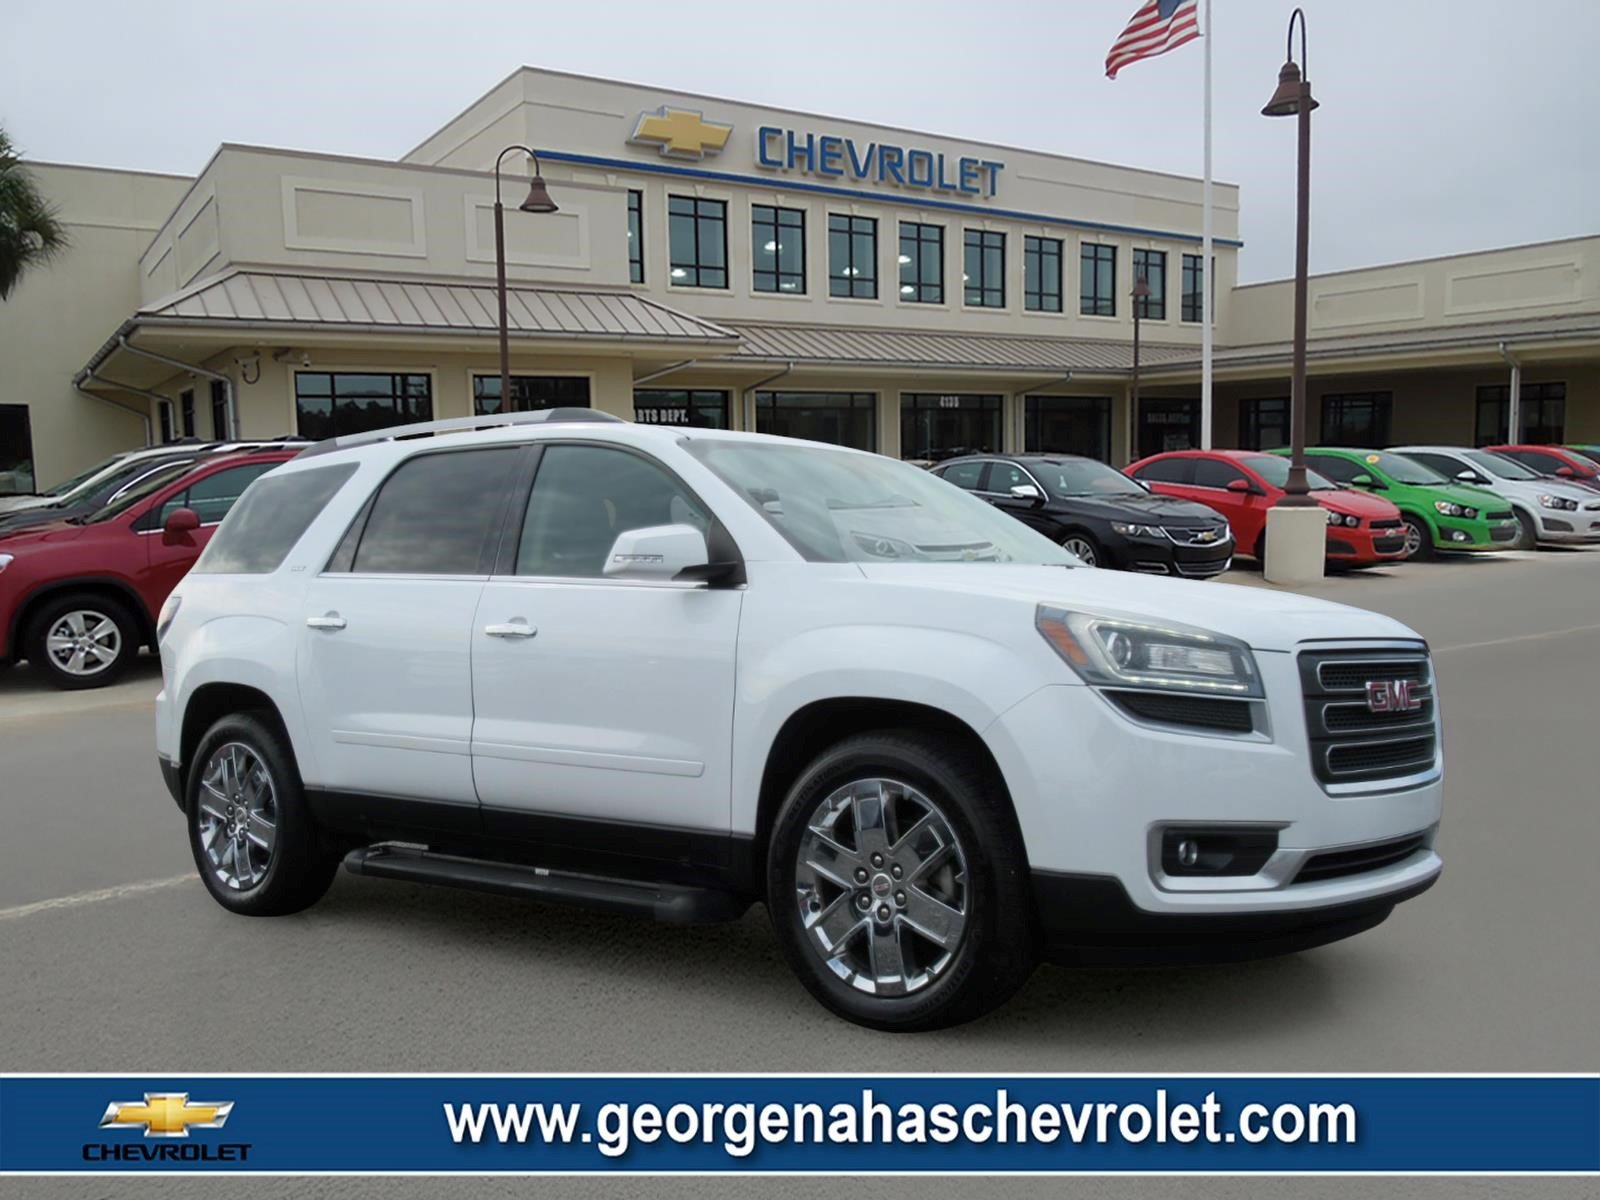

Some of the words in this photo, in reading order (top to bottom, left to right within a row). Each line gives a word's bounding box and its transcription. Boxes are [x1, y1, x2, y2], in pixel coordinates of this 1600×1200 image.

[757, 126, 1005, 197] CHEVROLET
[660, 409, 689, 423] DEPT.
[1365, 680, 1421, 712] GMC
